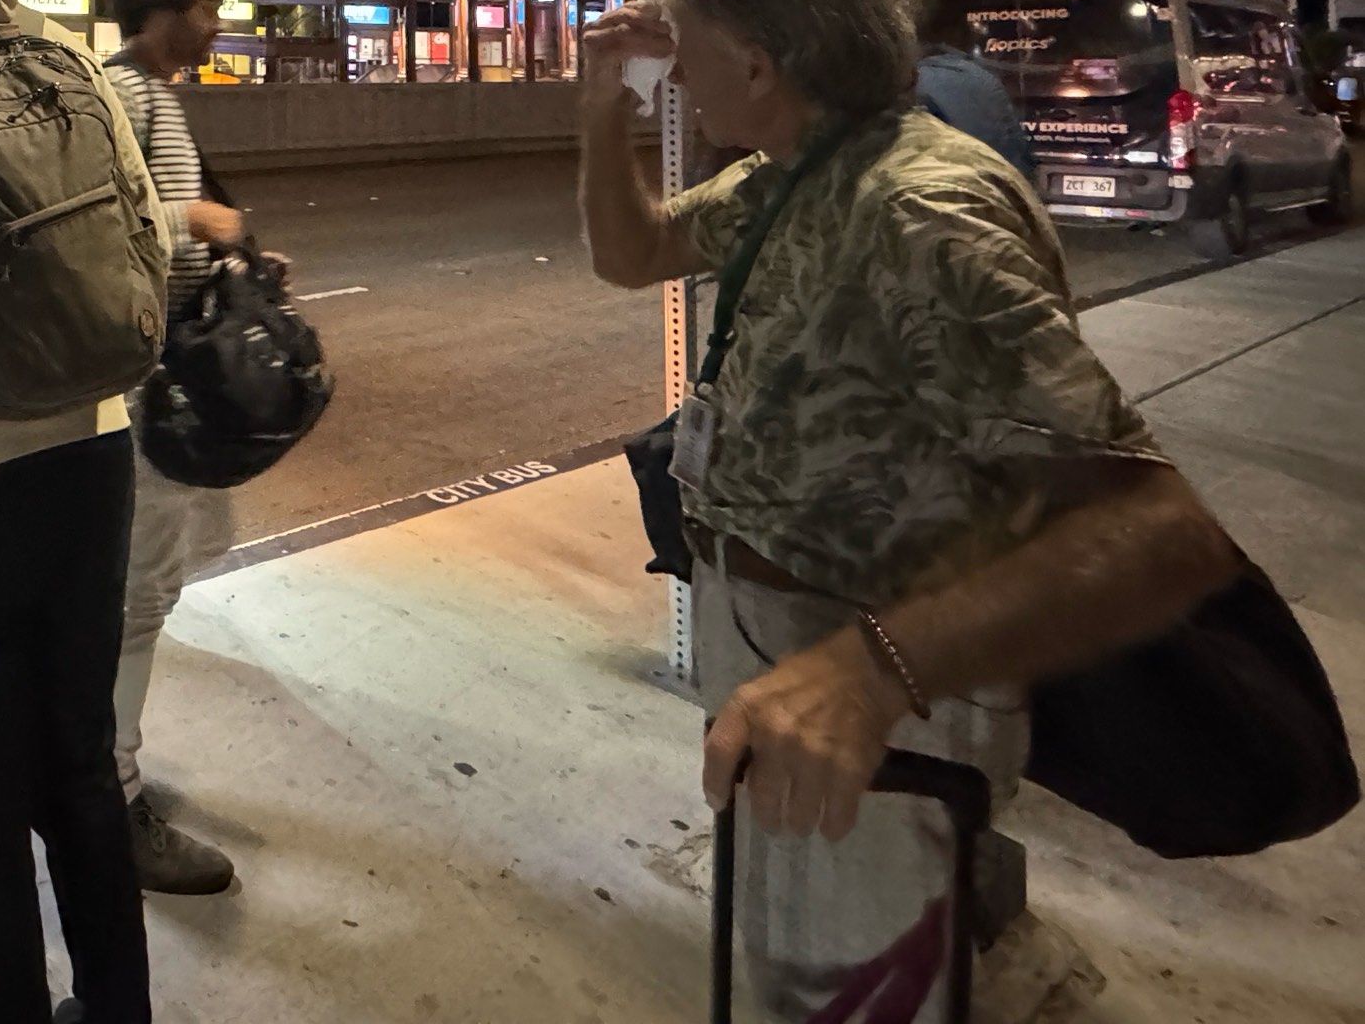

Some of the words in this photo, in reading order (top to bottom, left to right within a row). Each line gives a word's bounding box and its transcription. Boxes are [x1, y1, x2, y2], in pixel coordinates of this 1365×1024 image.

[967, 9, 1069, 21] INTRODUCING
[1039, 122, 1128, 134] EXPERIENCE
[1093, 182, 1112, 192] 367
[426, 475, 497, 504] CITY
[492, 460, 558, 485] BUS
